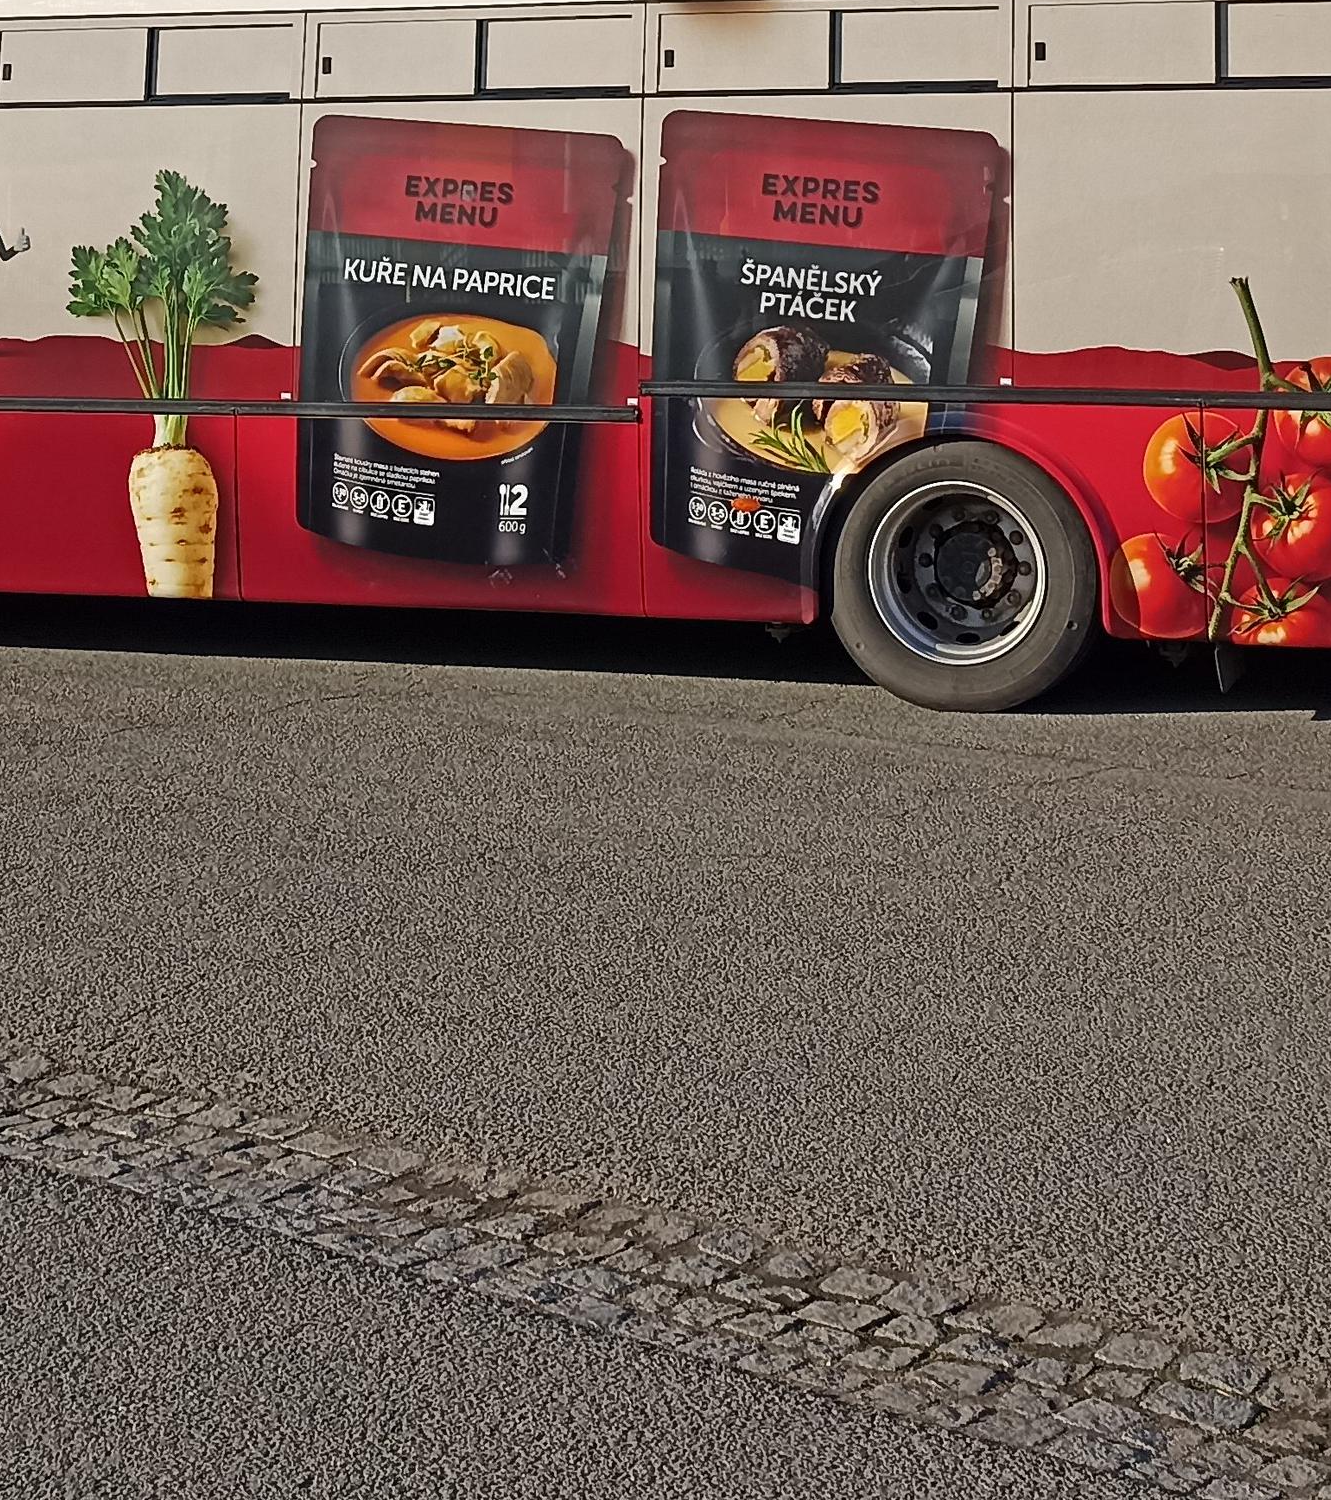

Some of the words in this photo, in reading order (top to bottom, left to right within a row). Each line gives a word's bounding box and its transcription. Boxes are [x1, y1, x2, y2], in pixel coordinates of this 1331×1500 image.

[405, 175, 514, 205] EXPRES
[762, 173, 881, 204] EXPRES
[415, 200, 499, 228] MENU
[773, 200, 864, 228] MENU
[344, 255, 408, 286] KUŘE
[412, 265, 447, 290] NA
[452, 268, 556, 300] PAPRICE
[740, 258, 883, 296] ŠPANĚLSKÝ
[759, 291, 857, 323] PTÁČEK
[498, 520, 519, 532] 600
[519, 523, 526, 535] g
